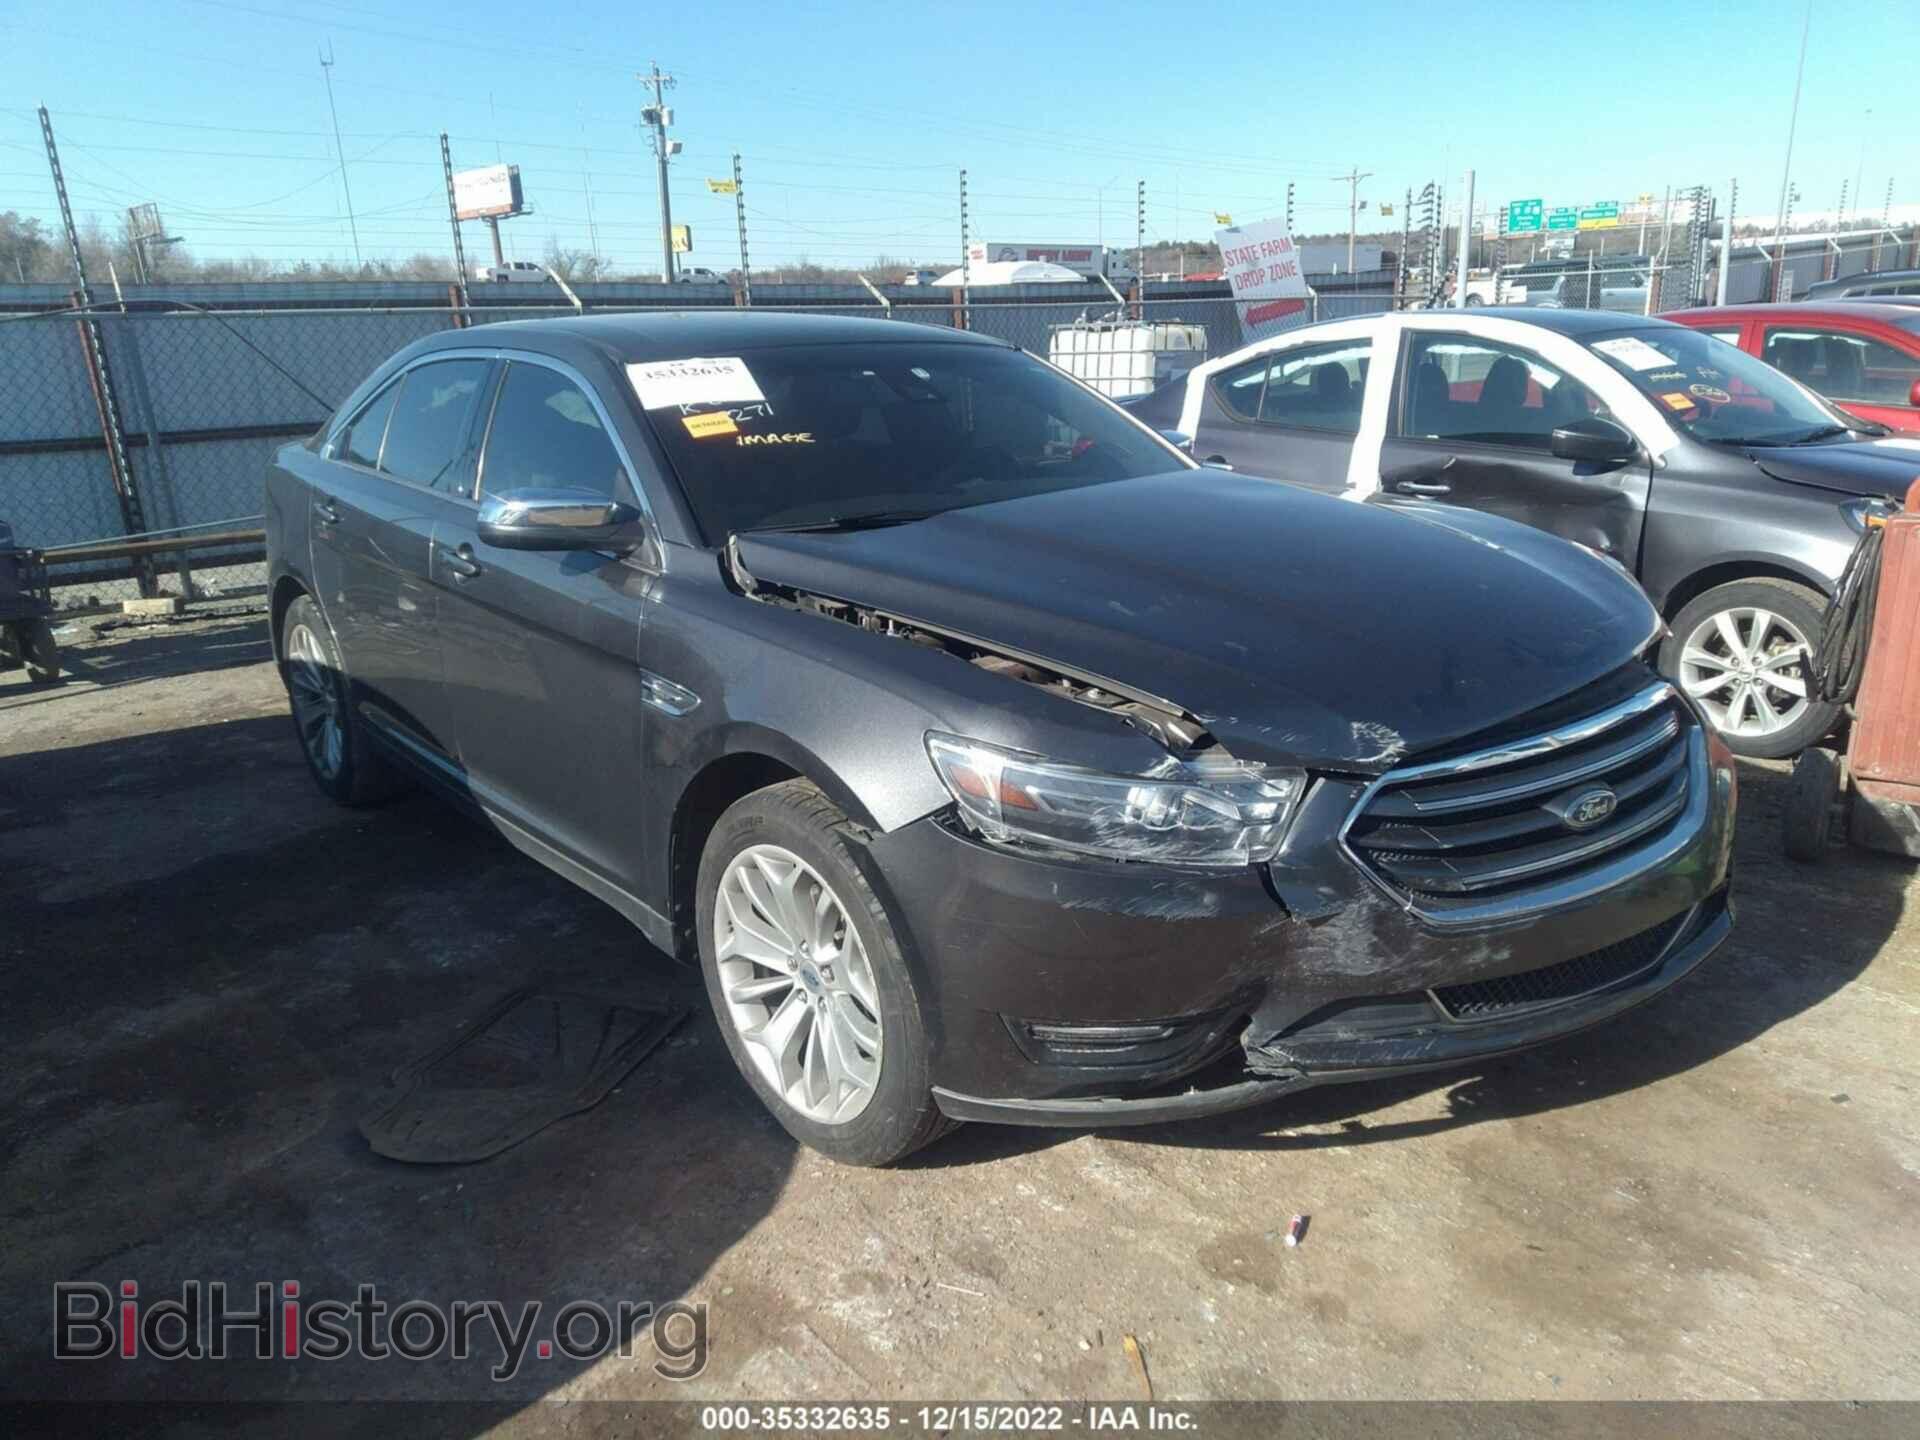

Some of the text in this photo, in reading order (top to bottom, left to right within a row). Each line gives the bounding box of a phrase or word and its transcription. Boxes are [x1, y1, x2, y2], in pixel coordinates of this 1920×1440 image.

[1224, 237, 1293, 267] STATE FARM
[1234, 260, 1298, 290] DROP ZONE
[736, 432, 816, 447] IMAGE
[1578, 797, 1609, 822] Ford
